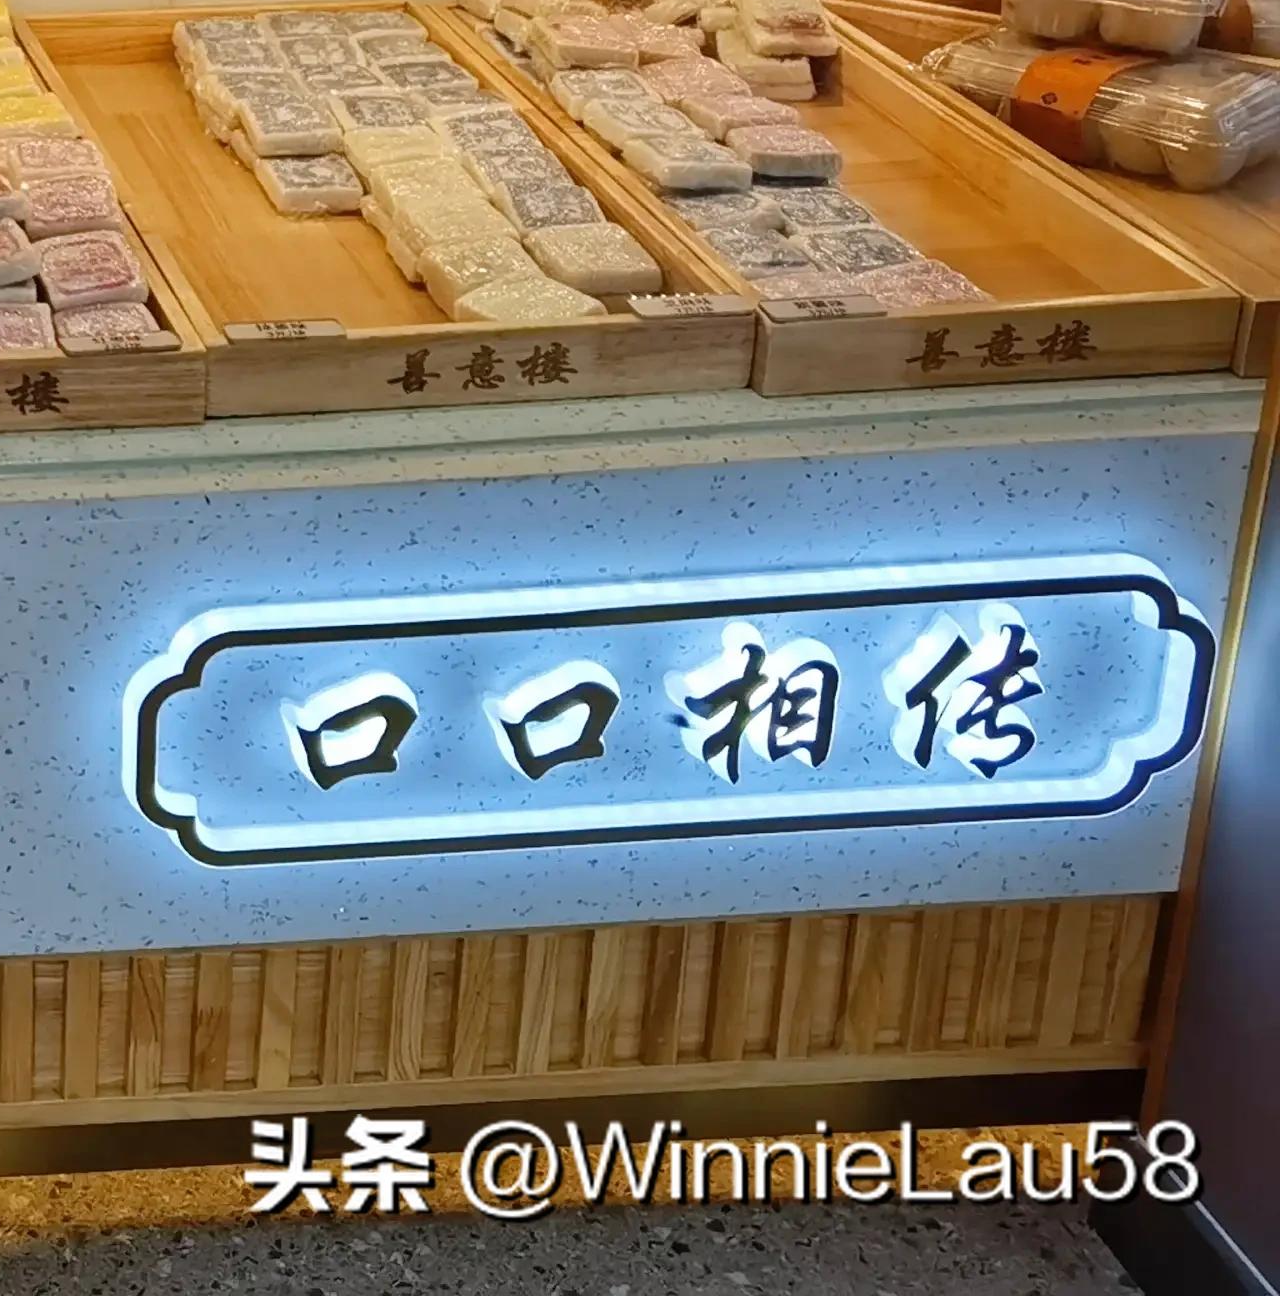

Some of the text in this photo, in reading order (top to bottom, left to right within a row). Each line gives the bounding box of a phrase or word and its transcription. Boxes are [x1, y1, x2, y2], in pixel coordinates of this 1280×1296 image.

[386, 341, 579, 395] 善意楼
[906, 319, 1098, 373] 善意楼
[292, 621, 1044, 792] 口口相传
